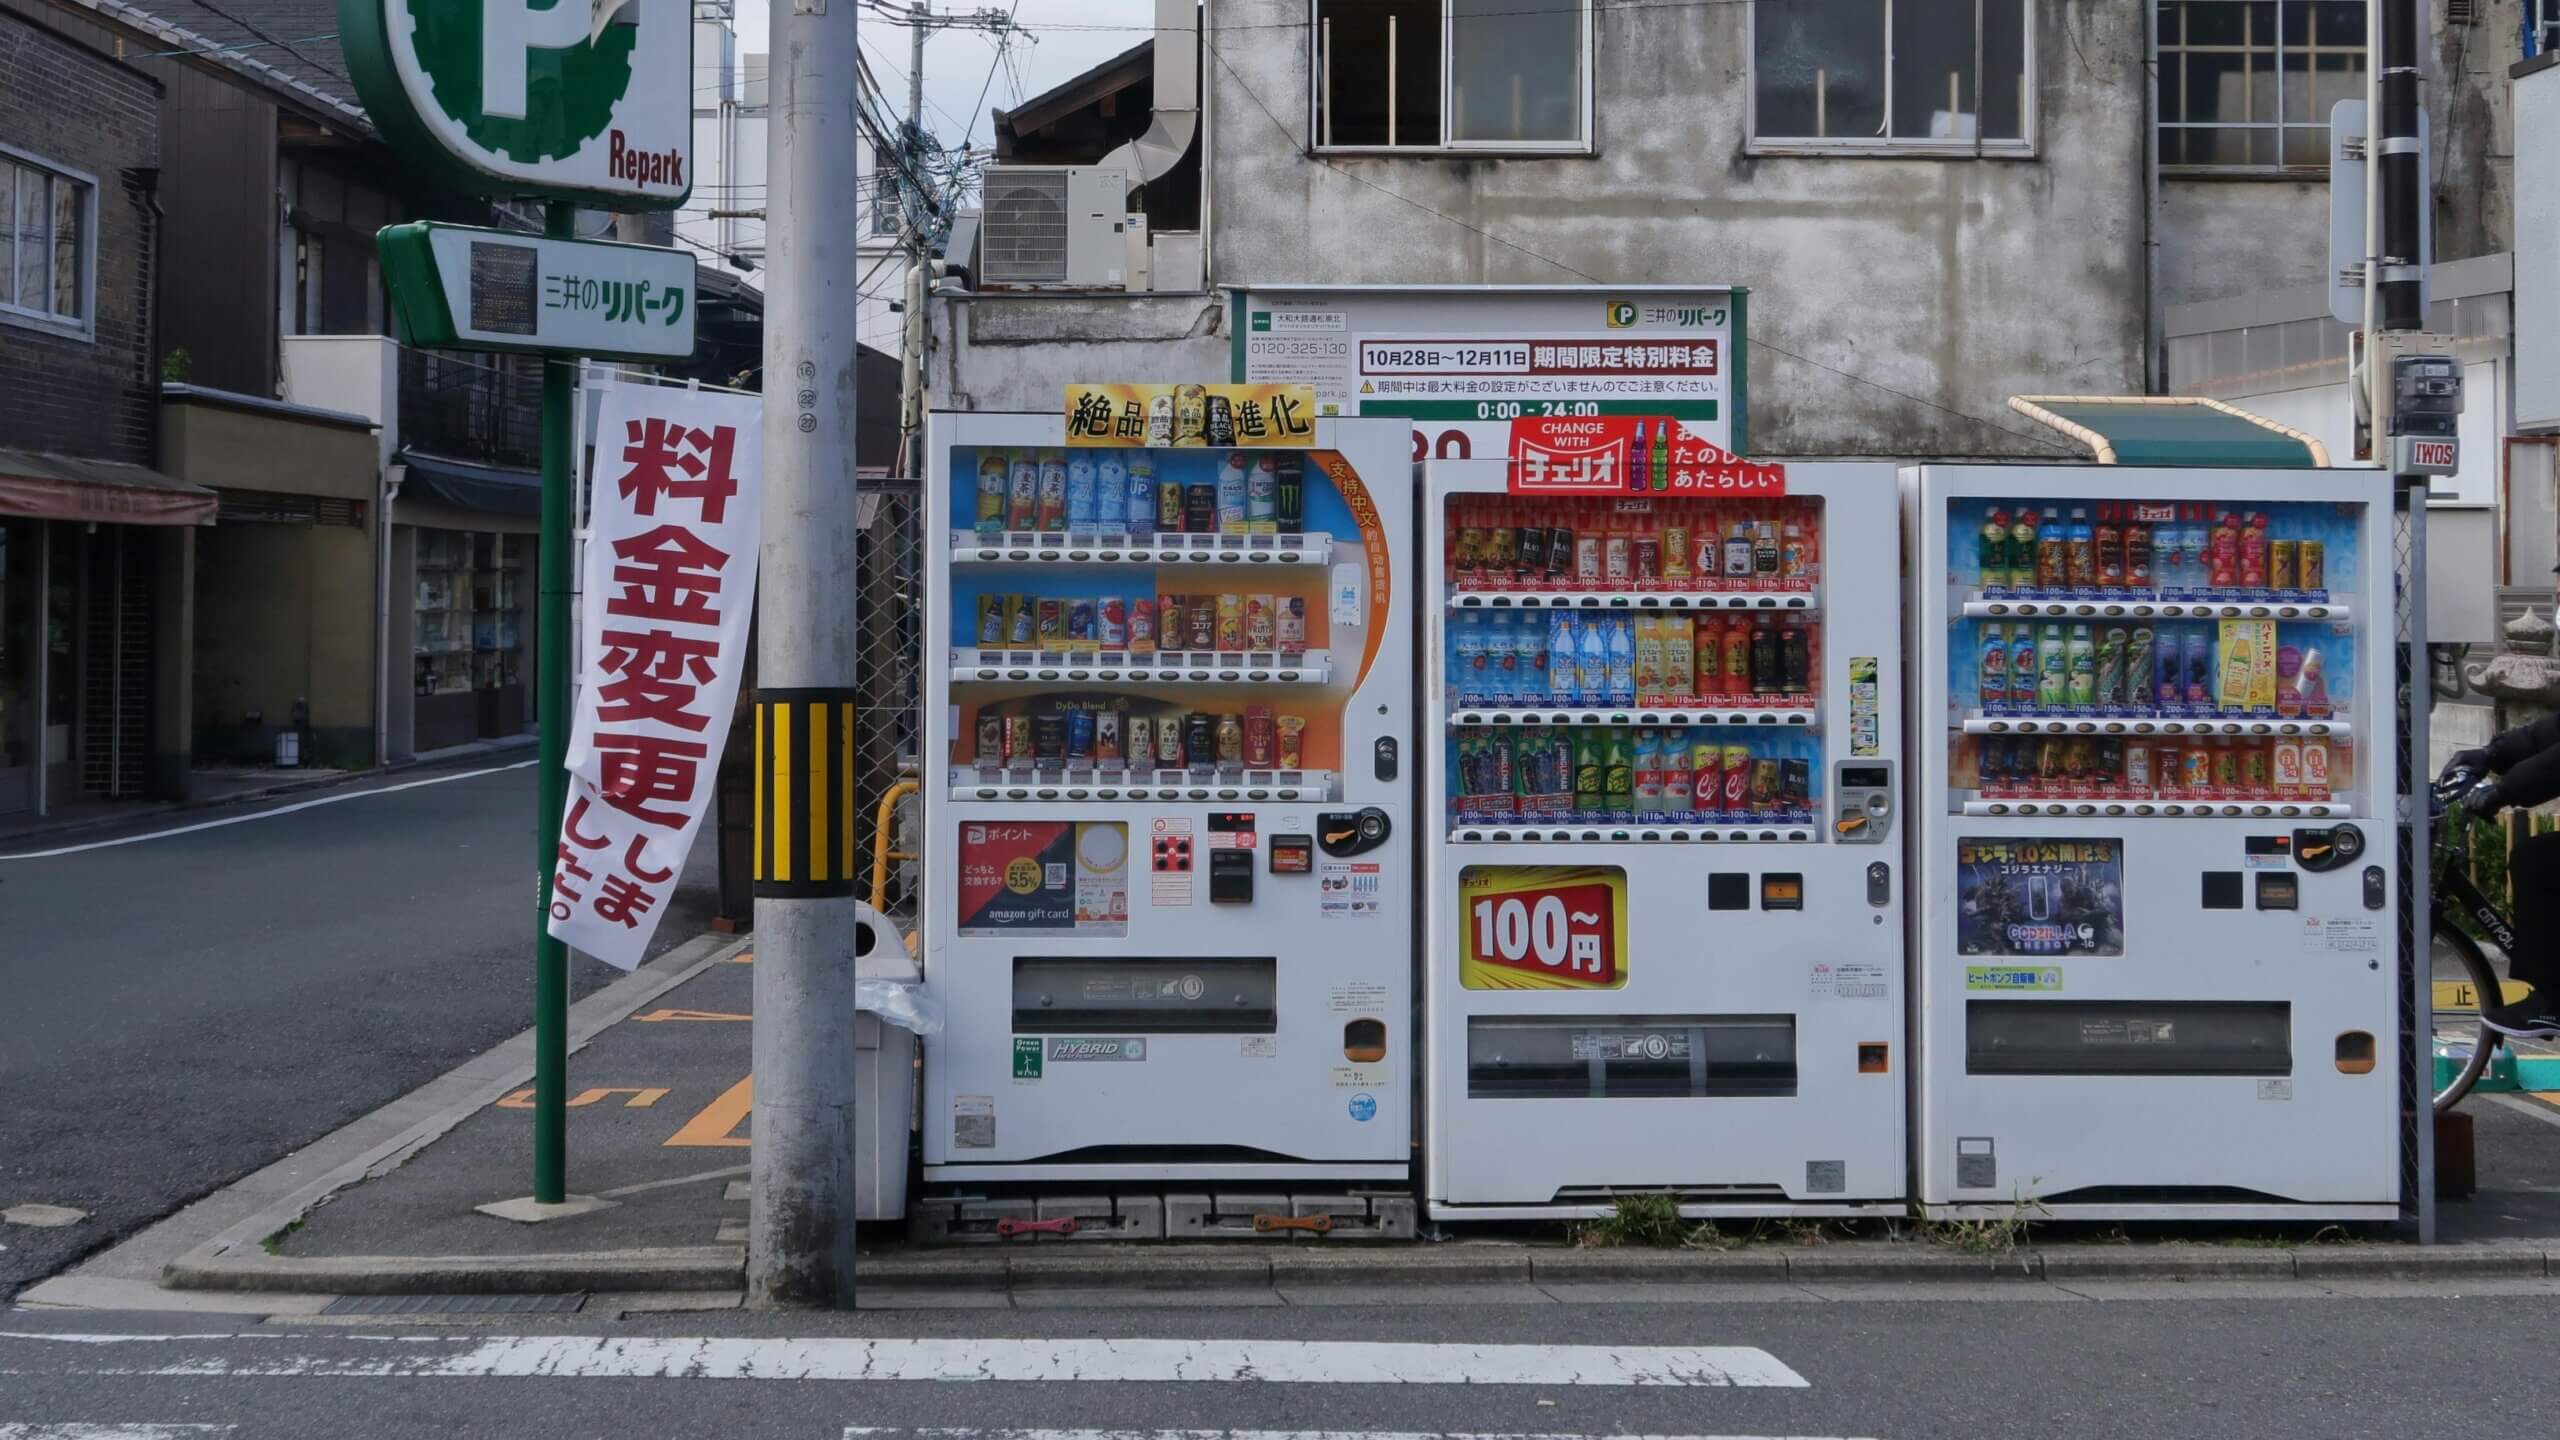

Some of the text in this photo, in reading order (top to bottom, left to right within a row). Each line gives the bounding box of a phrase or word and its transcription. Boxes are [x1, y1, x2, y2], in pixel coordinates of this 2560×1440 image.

[609, 129, 683, 187] Repark
[544, 273, 684, 328] 三井のリパーク
[1646, 307, 1726, 327] 三井のリパーク
[1251, 343, 1347, 354] 0120-325-130
[1534, 346, 1714, 368] 期間限定特別料金
[1378, 380, 1718, 393] 期間中は最大料金の設定がございませんのでご注意ください。
[1068, 391, 1312, 438] 絶品 進化
[1477, 402, 1521, 418] 0:00
[1541, 402, 1599, 417] 24:00
[1541, 422, 1605, 435] CHANGE
[1554, 436, 1590, 448] WITH
[2415, 443, 2454, 465] IWOS
[1526, 449, 1615, 483] チェリオ
[1674, 470, 1778, 488] あたらしい
[593, 416, 738, 831] 料金変更
[988, 828, 1032, 840] ポイント
[593, 833, 674, 930] しま
[989, 908, 1069, 920] amazon gift card
[2454, 985, 2473, 1006] 止
[1054, 1043, 1119, 1056] HYBRID
